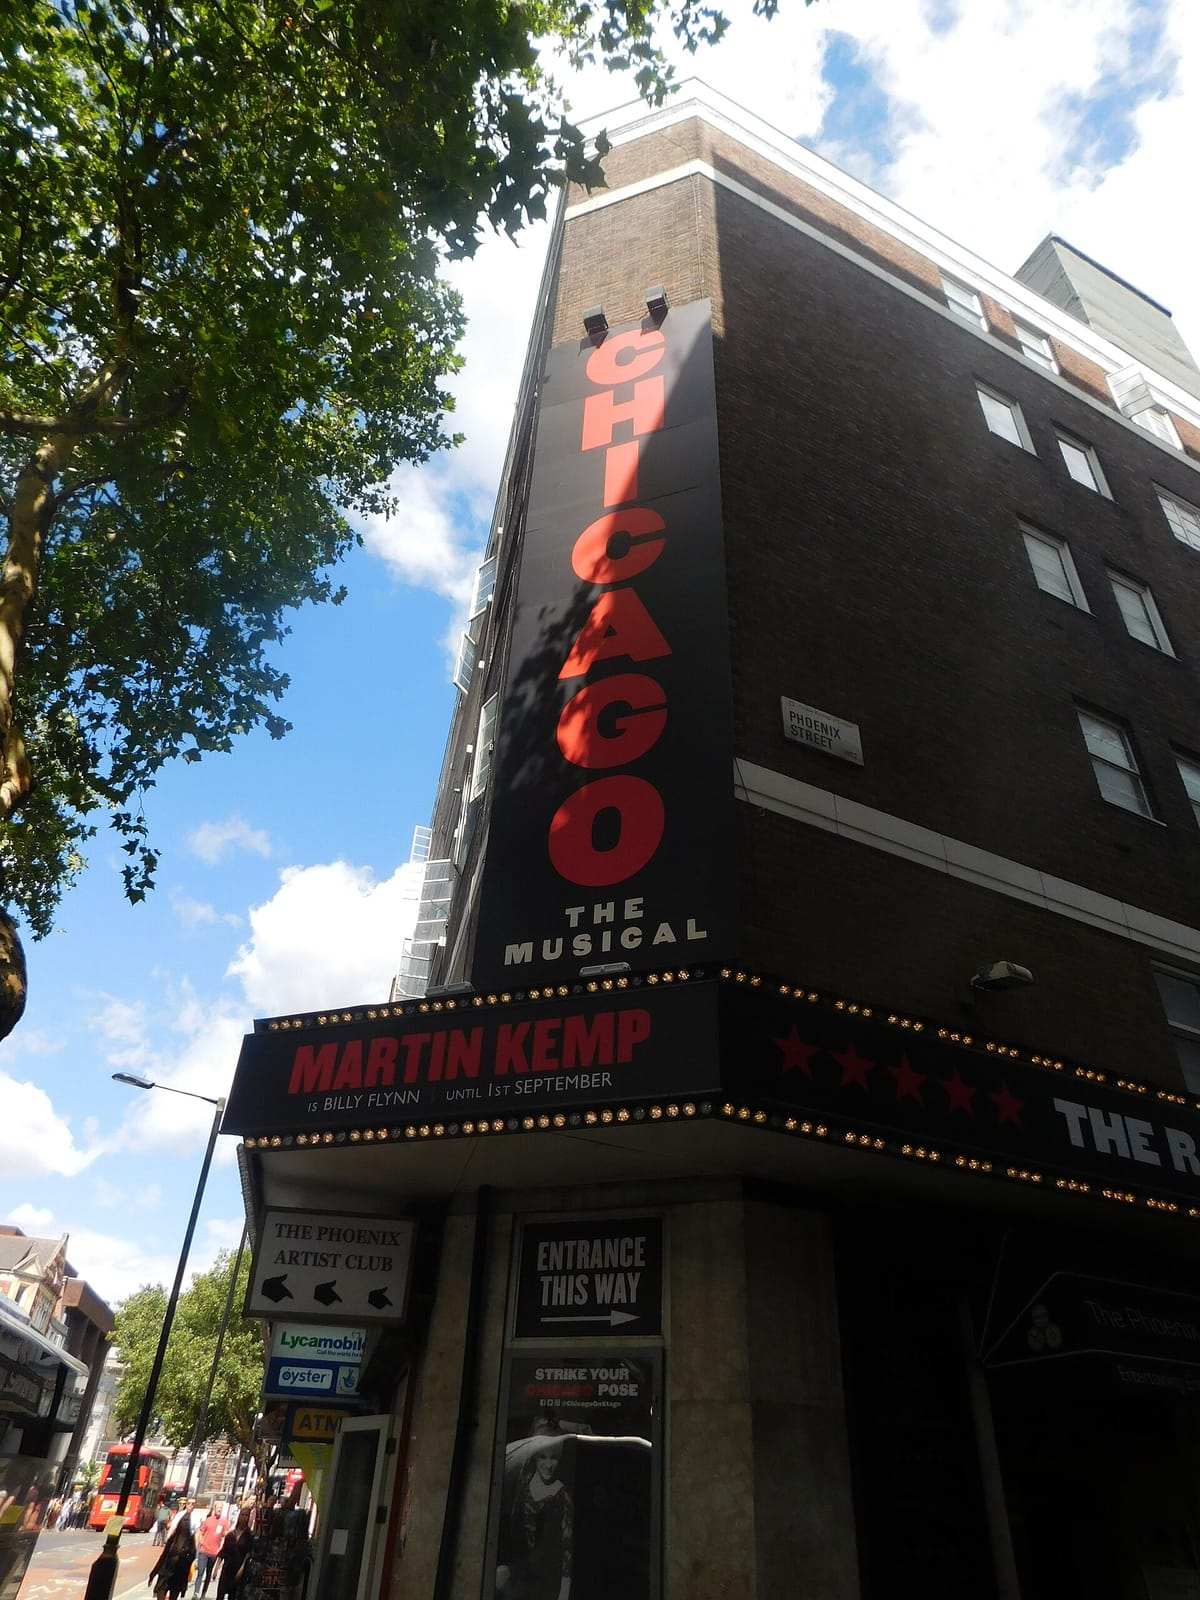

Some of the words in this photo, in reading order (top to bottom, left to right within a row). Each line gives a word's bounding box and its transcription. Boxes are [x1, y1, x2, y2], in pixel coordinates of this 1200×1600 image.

[548, 329, 672, 887] CHICAGO
[789, 711, 841, 739] PHOENIX
[791, 724, 833, 749] STREET
[565, 897, 644, 928] THE
[504, 918, 707, 965] MUSICAL
[287, 1026, 483, 1094] MARTIN
[495, 1009, 651, 1076] KEMP
[323, 1095, 363, 1112] BILLY
[368, 1089, 420, 1108] FLYNN
[446, 1088, 482, 1101] UNTIL
[514, 1071, 612, 1094] SEPTEMBER
[1053, 1097, 1161, 1167] THE
[275, 1223, 313, 1240] THE
[317, 1226, 401, 1246] PHOENIX
[273, 1249, 342, 1268] ARTIST
[345, 1253, 393, 1272] CLUB
[537, 1236, 646, 1271] ENTRANCE
[540, 1274, 589, 1306] THIS
[594, 1272, 641, 1304] WAY
[281, 1368, 327, 1385] oyster
[535, 1368, 587, 1381] STRIKE
[589, 1367, 629, 1380] YOUR
[598, 1384, 638, 1397] POSE
